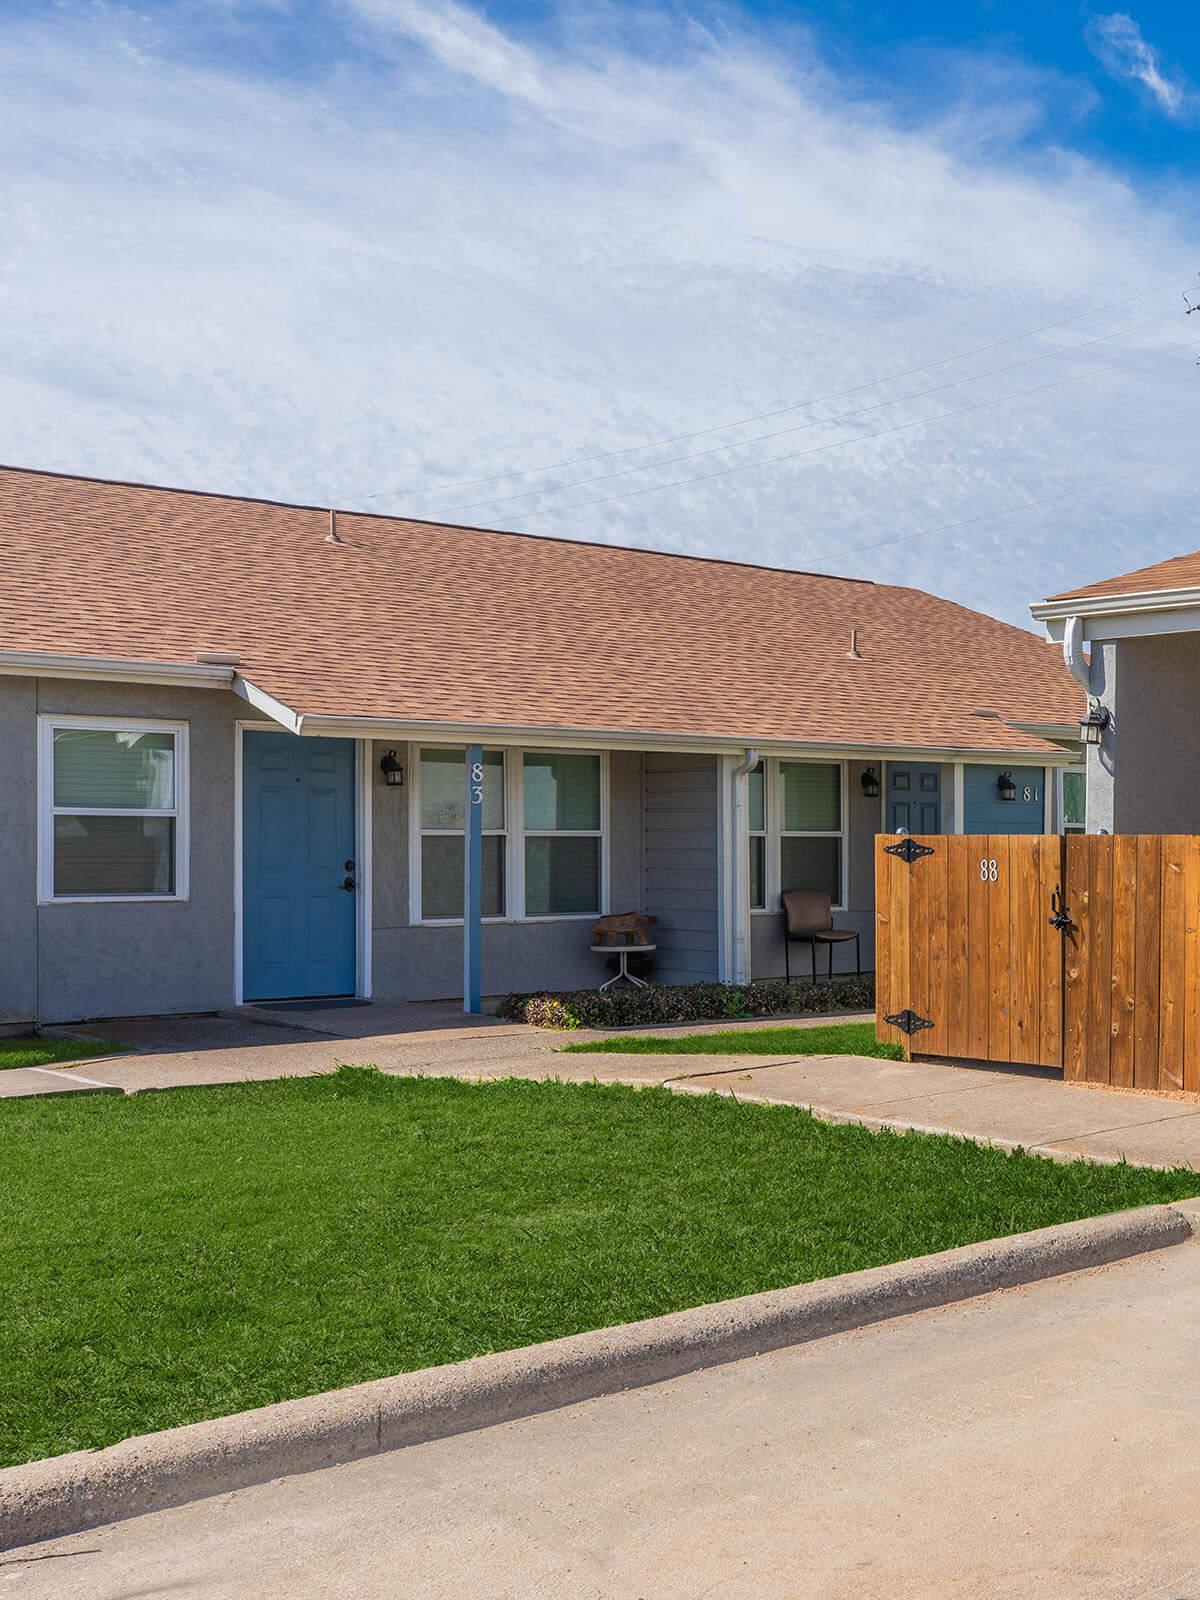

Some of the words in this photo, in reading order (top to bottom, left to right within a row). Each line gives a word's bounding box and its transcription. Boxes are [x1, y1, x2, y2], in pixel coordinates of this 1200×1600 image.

[471, 762, 484, 804] 83
[1023, 786, 1039, 802] 81
[980, 859, 998, 882] 88
